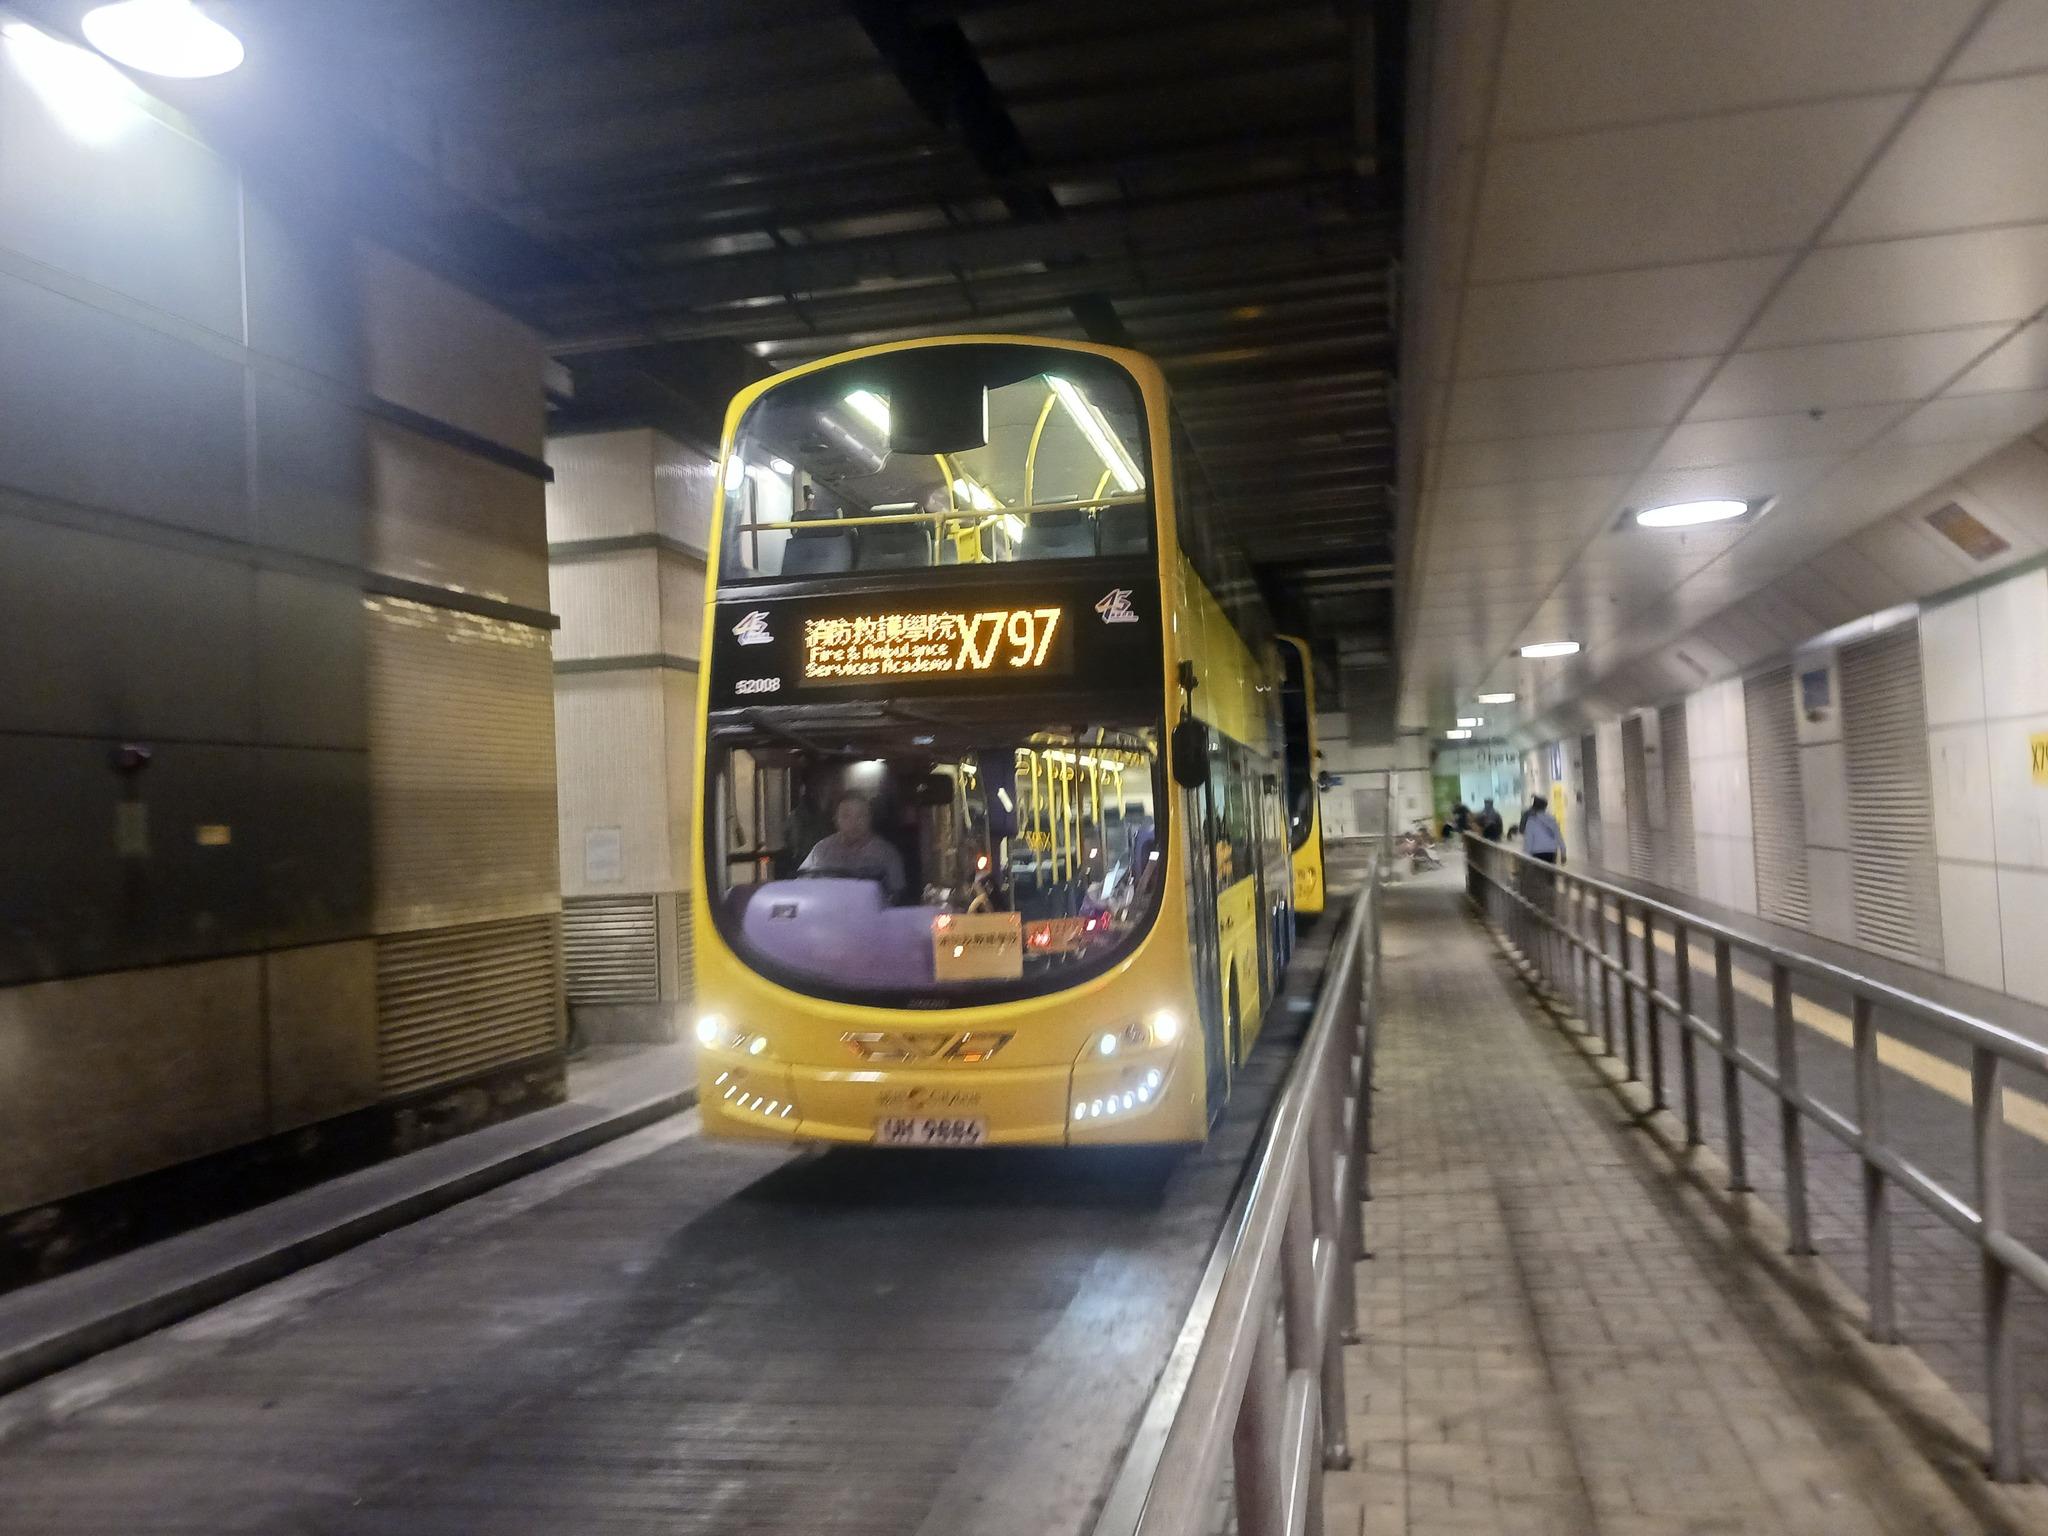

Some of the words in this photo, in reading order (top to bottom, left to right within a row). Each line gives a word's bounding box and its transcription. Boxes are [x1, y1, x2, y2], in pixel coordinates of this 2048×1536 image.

[804, 612, 957, 648] 消防救護學院
[954, 607, 1062, 671] X797
[809, 647, 845, 662] Fire
[847, 645, 861, 661] &
[862, 641, 949, 660] Ambulance
[804, 660, 880, 678] Services
[882, 656, 953, 674] Academy
